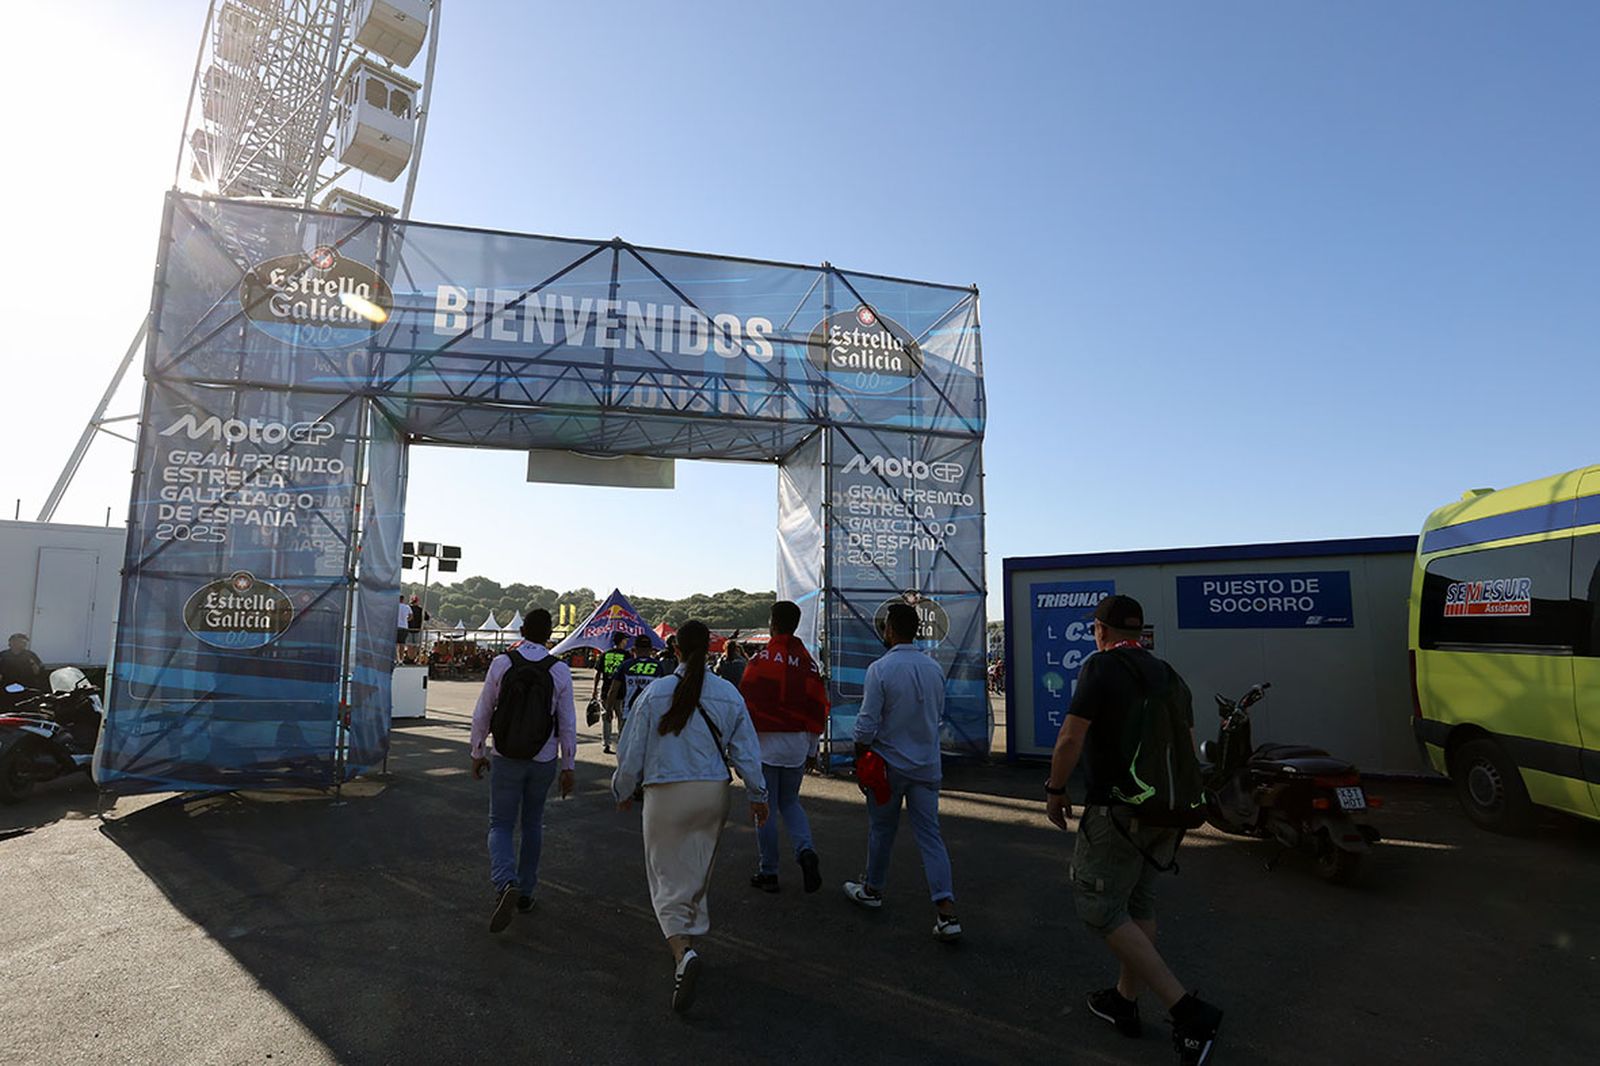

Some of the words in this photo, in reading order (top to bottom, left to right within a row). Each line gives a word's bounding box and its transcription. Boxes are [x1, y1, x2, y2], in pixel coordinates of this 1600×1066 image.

[267, 268, 371, 299] Estrella
[433, 285, 773, 363] BIENVENIDOS
[828, 325, 904, 352] Estrella
[831, 346, 903, 371] Galicia
[159, 414, 335, 445] MotoGP
[168, 450, 236, 467] GRAN
[240, 453, 344, 474] PREMIO
[840, 454, 964, 483] MotoGP
[163, 466, 285, 488] ESTRELLA
[160, 486, 270, 506] GALICIA
[848, 485, 900, 500] GRAN
[903, 488, 974, 507] PREMIO
[158, 504, 193, 521] DE
[198, 507, 297, 527] ESPAÑA
[849, 501, 935, 519] ESTRELLA
[155, 523, 227, 543] 2025
[849, 517, 924, 536] GALICIA
[848, 533, 872, 548] DE
[848, 550, 898, 566] 2025
[1203, 579, 1284, 596] PUESTO
[1291, 578, 1320, 593] DE
[1447, 577, 1531, 603] SEMESUR
[204, 591, 276, 611] Estrella
[1209, 596, 1314, 613] SOCORRO
[1485, 602, 1529, 613] Assistance
[206, 609, 271, 629] Galicia
[583, 621, 614, 639] Red
[616, 620, 646, 638] Bull
[629, 662, 658, 675] 46
